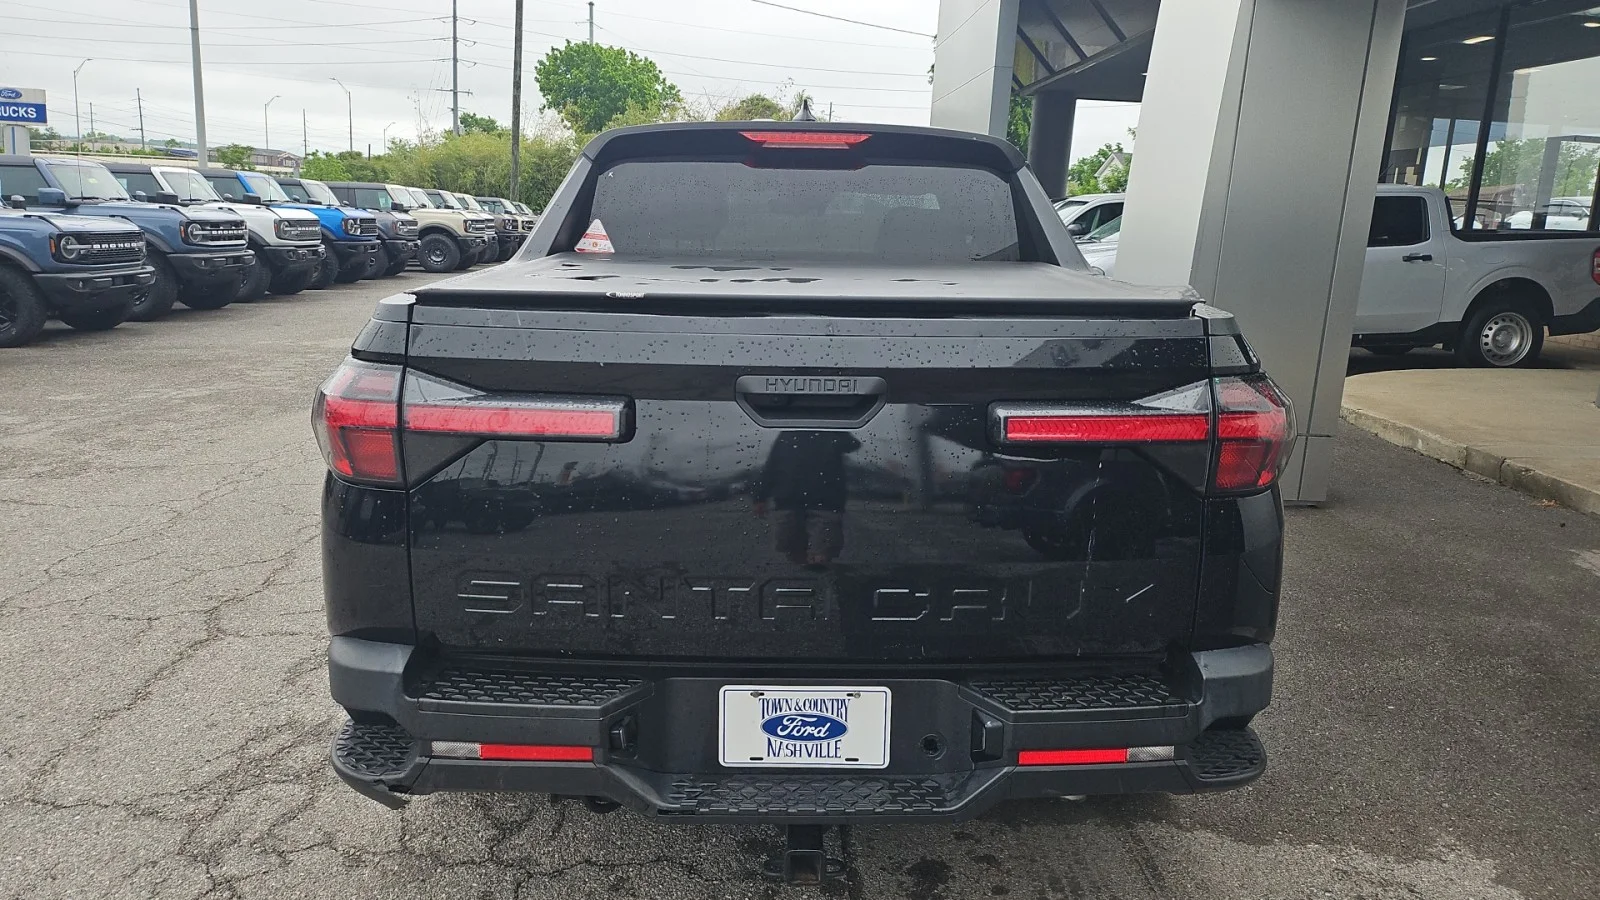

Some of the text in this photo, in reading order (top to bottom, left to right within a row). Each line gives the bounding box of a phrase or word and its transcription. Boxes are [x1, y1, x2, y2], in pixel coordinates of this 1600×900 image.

[1, 90, 16, 98] Ford
[0, 105, 37, 118] UCKS
[765, 378, 858, 392] HYUNDAI
[455, 570, 831, 621] SANTA
[776, 715, 830, 738] Ford
[767, 738, 842, 759] NASHVILLE
